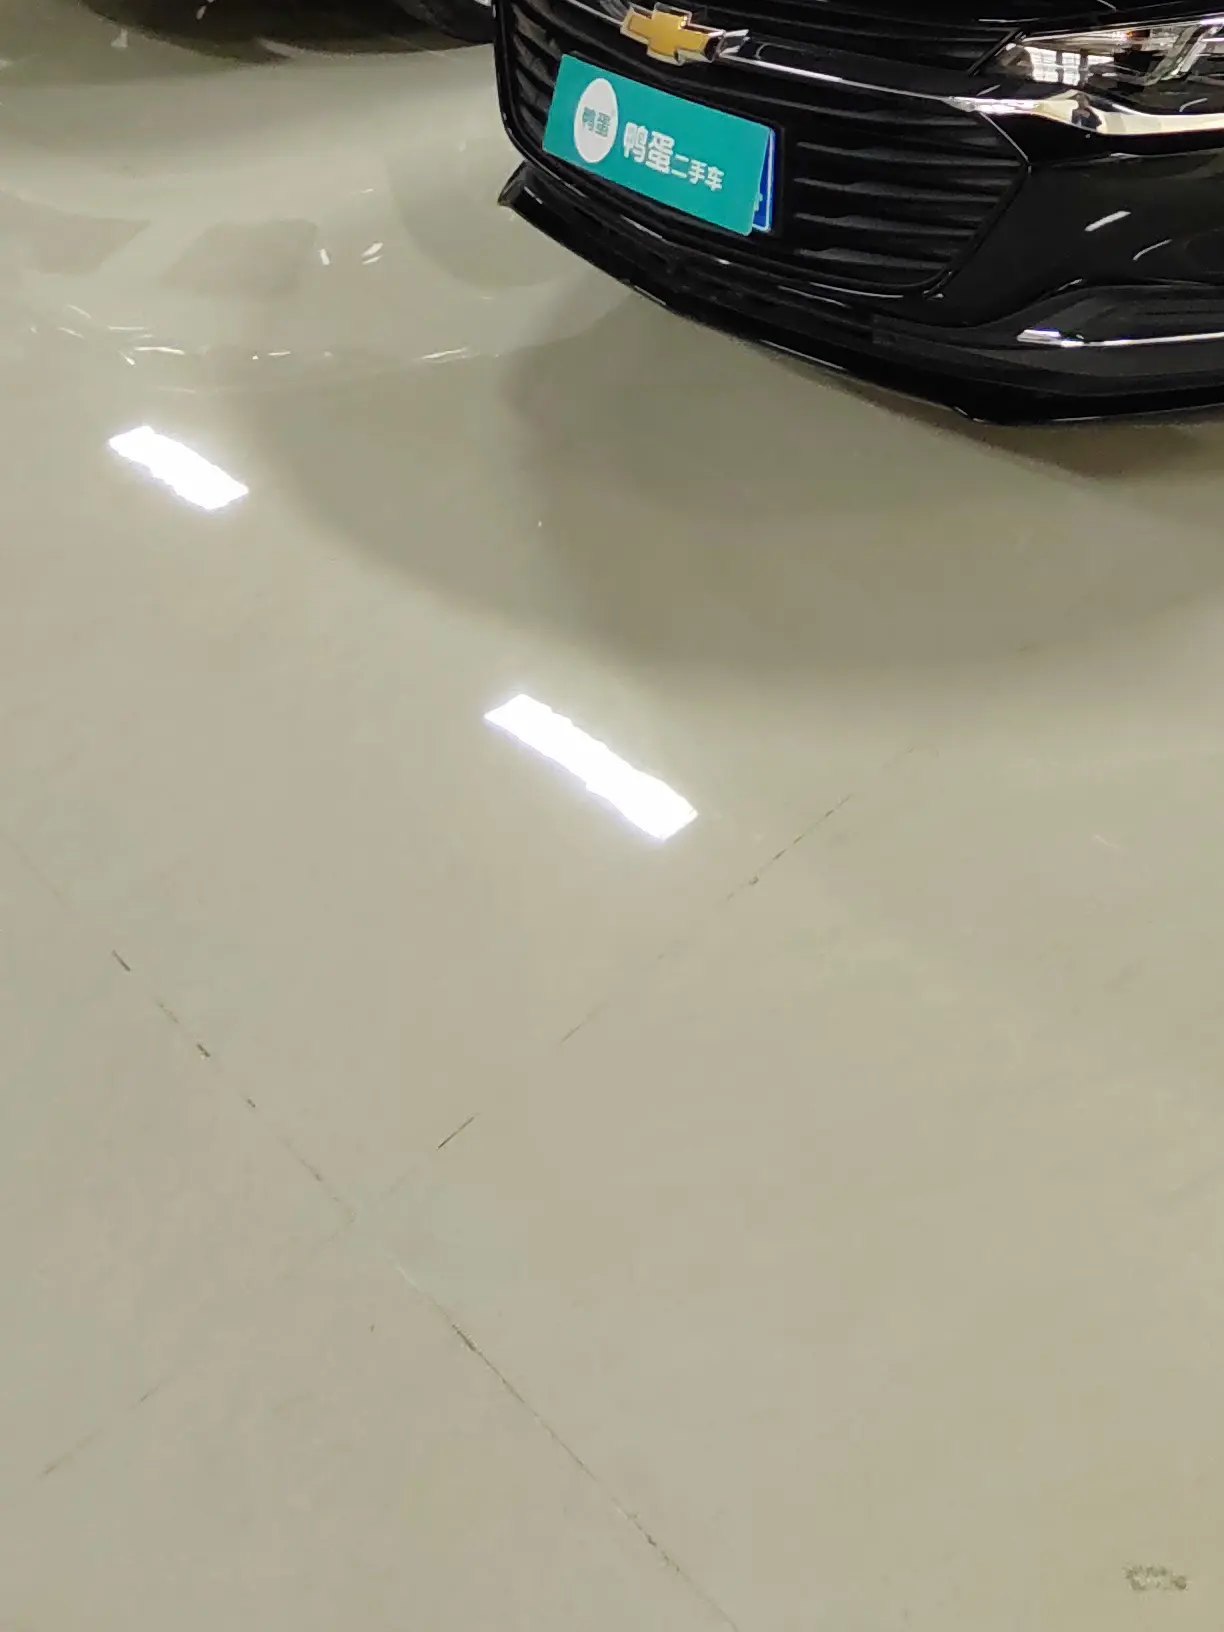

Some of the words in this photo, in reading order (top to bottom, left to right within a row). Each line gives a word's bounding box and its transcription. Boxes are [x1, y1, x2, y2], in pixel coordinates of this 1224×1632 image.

[623, 121, 725, 192] 鸭蛋二手车
